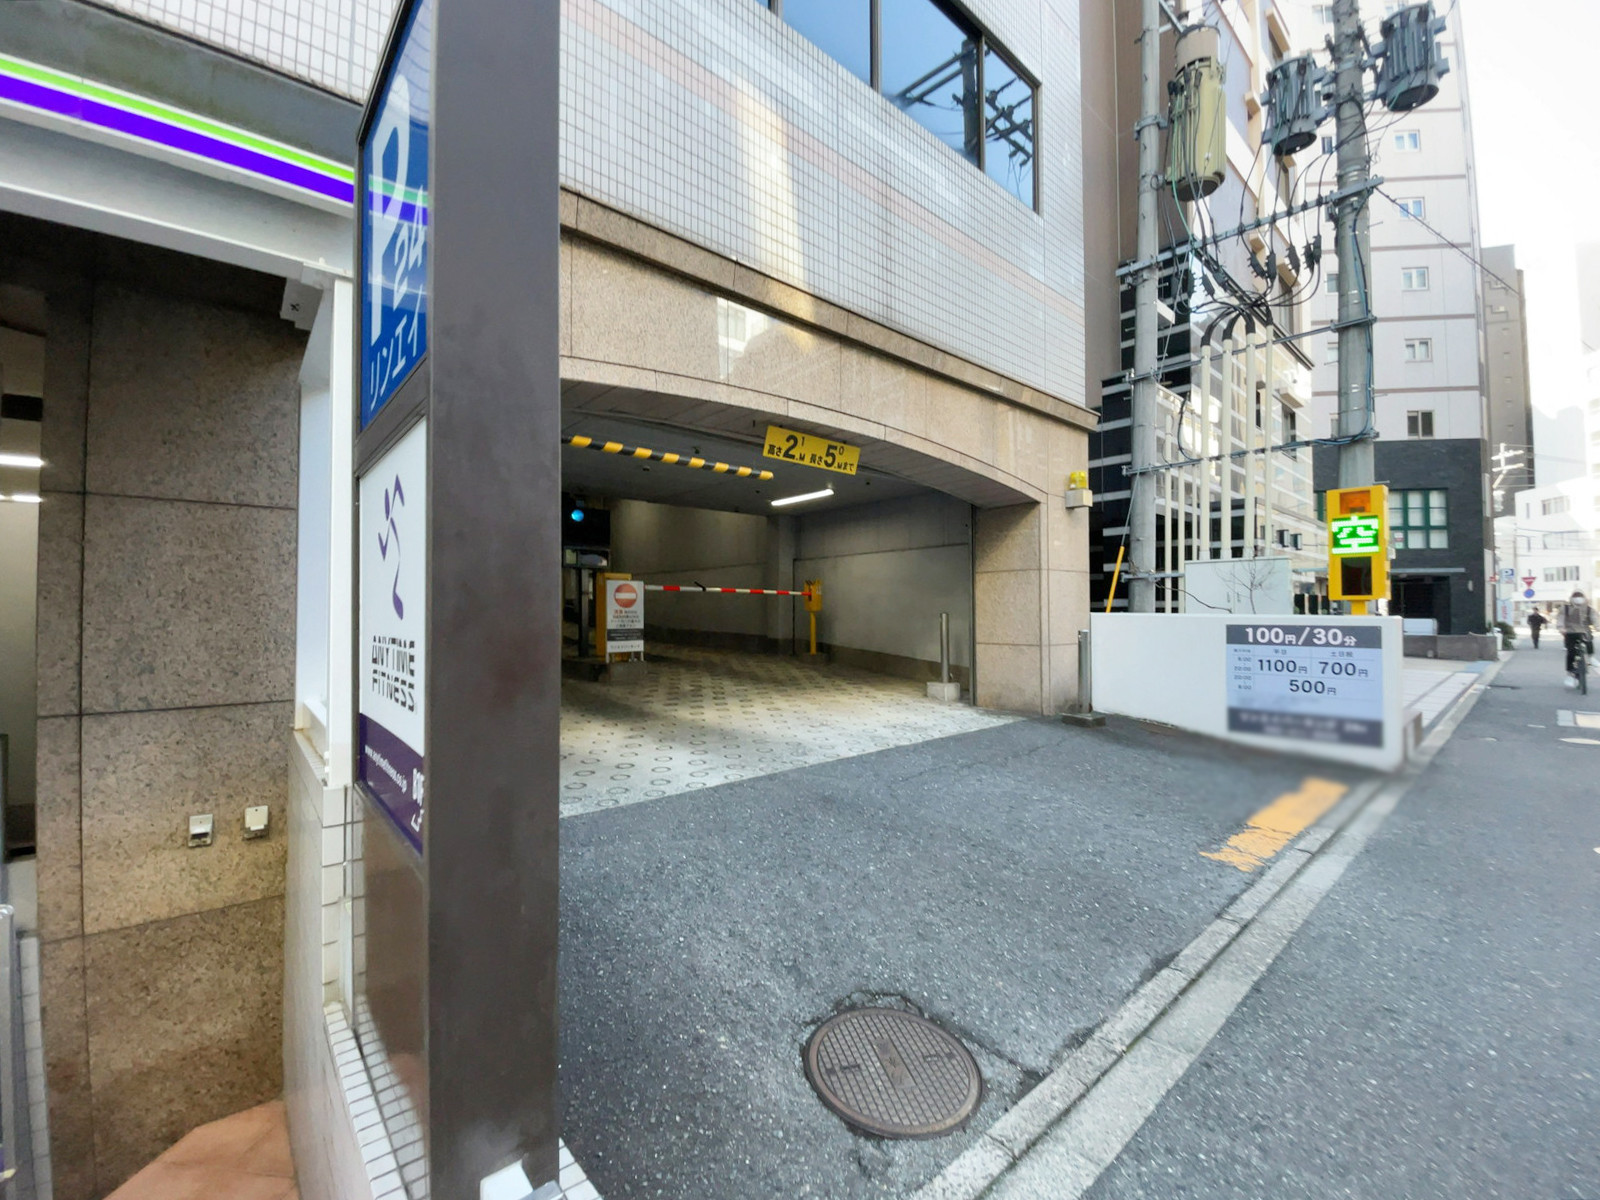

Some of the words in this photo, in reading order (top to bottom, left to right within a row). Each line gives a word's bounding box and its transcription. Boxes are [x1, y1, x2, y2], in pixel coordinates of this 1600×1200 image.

[372, 73, 410, 346] P
[1331, 515, 1380, 554] 空
[1245, 627, 1358, 647] 100円/30分
[371, 635, 416, 678] ANYTIME
[1257, 659, 1308, 675] 1100円
[1318, 661, 1369, 678] 700円
[372, 669, 415, 713] FITNESS
[1289, 680, 1337, 696] 500円
